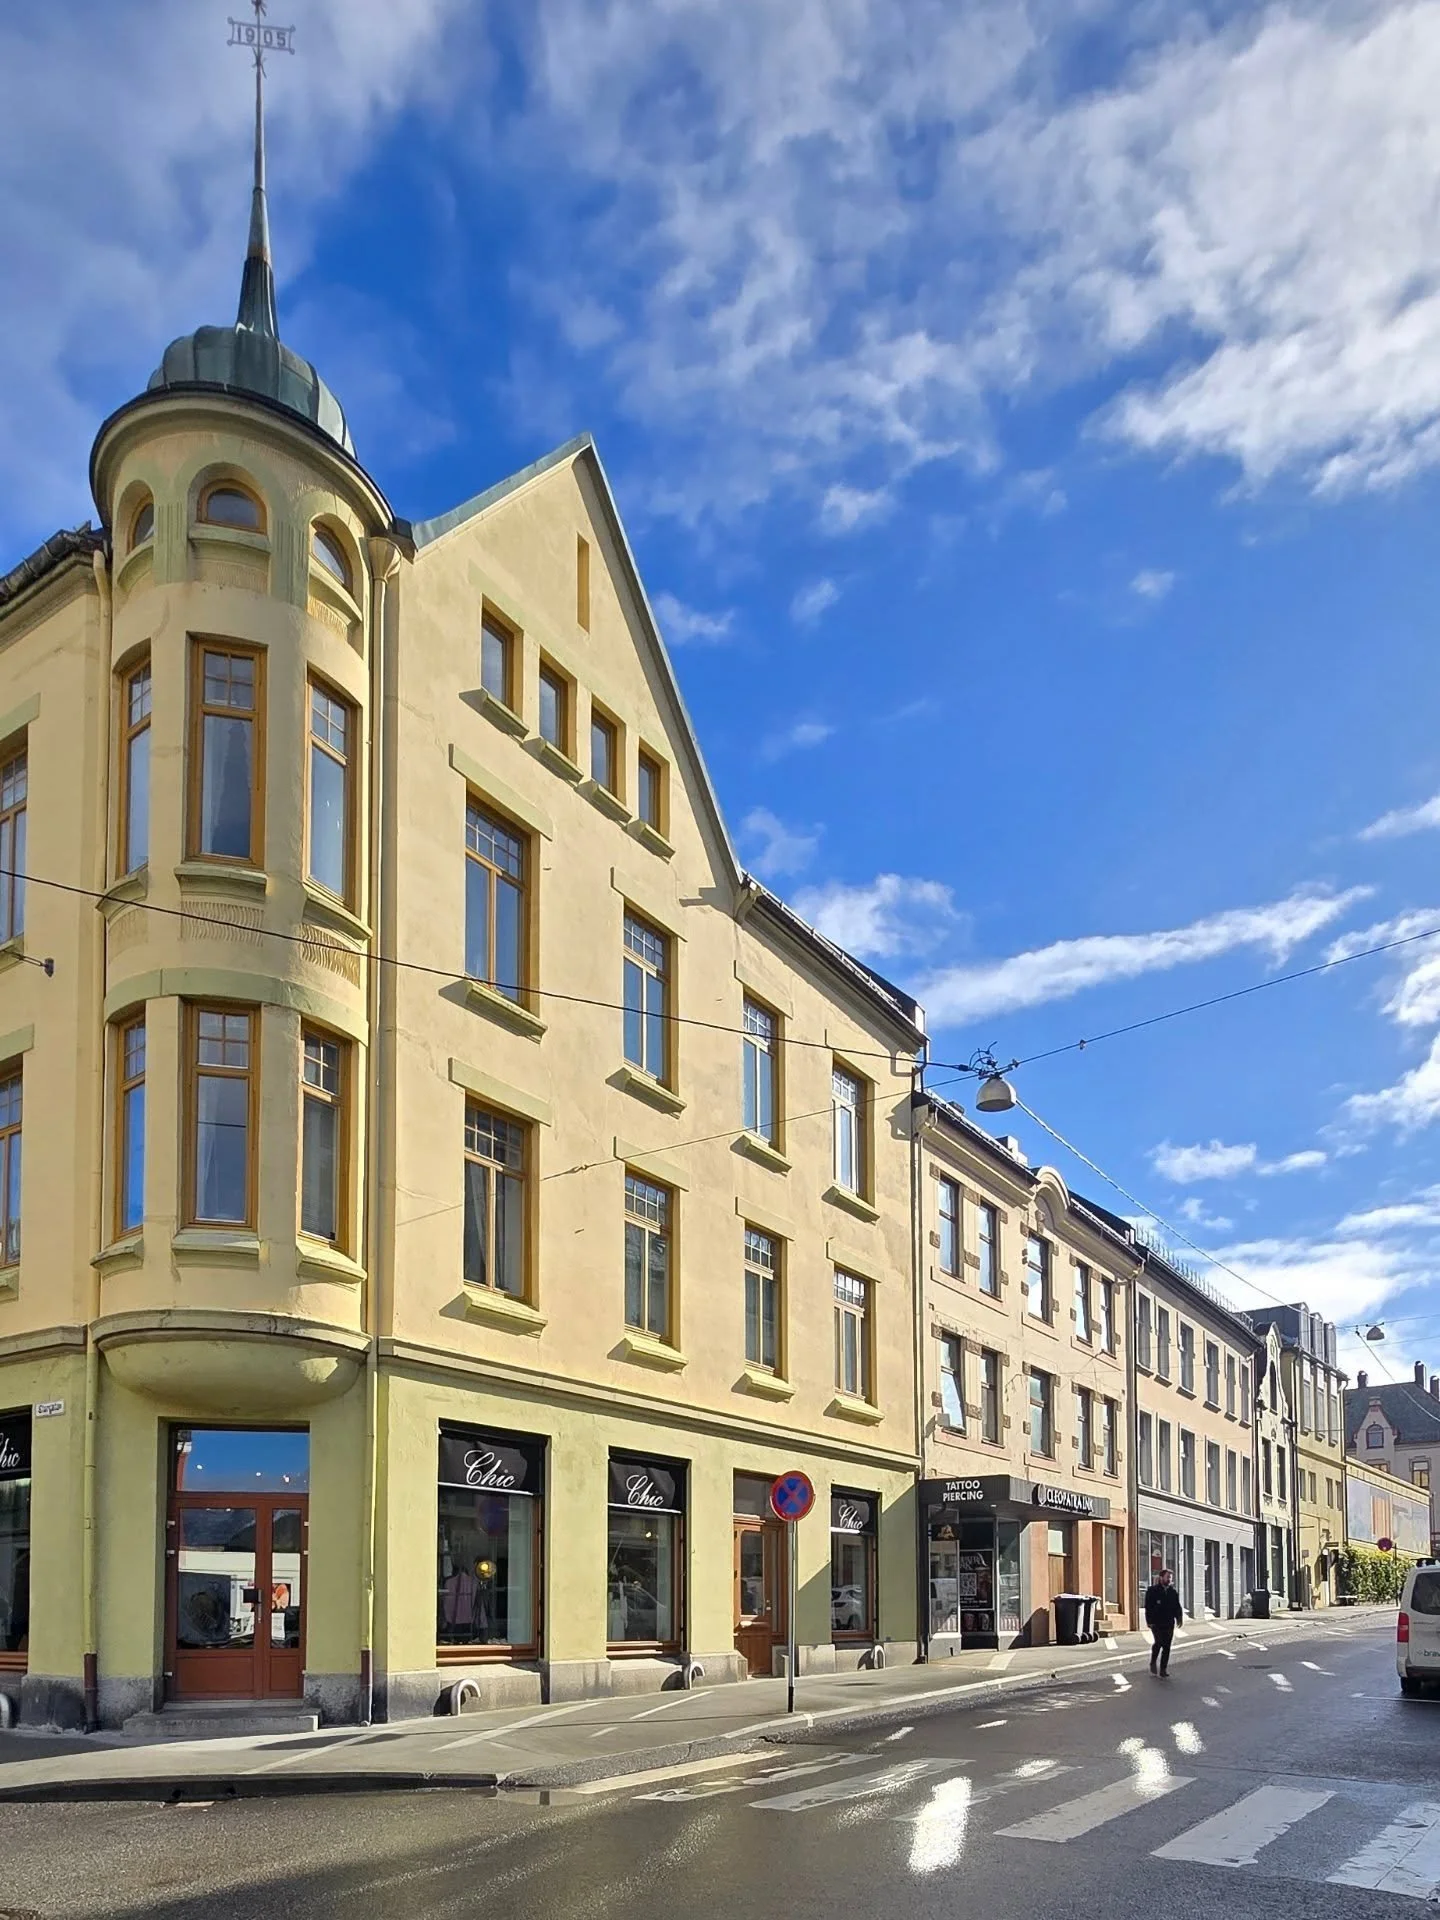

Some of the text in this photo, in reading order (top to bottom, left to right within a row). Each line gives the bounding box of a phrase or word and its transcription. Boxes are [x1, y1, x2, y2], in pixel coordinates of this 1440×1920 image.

[237, 24, 286, 47] 1905
[0, 1432, 20, 1468] hic
[464, 1449, 515, 1487] Chic
[626, 1474, 664, 1506] Chic
[943, 1490, 984, 1502] PIERCING
[945, 1480, 980, 1491] TATTOO
[838, 1504, 863, 1529] Chic
